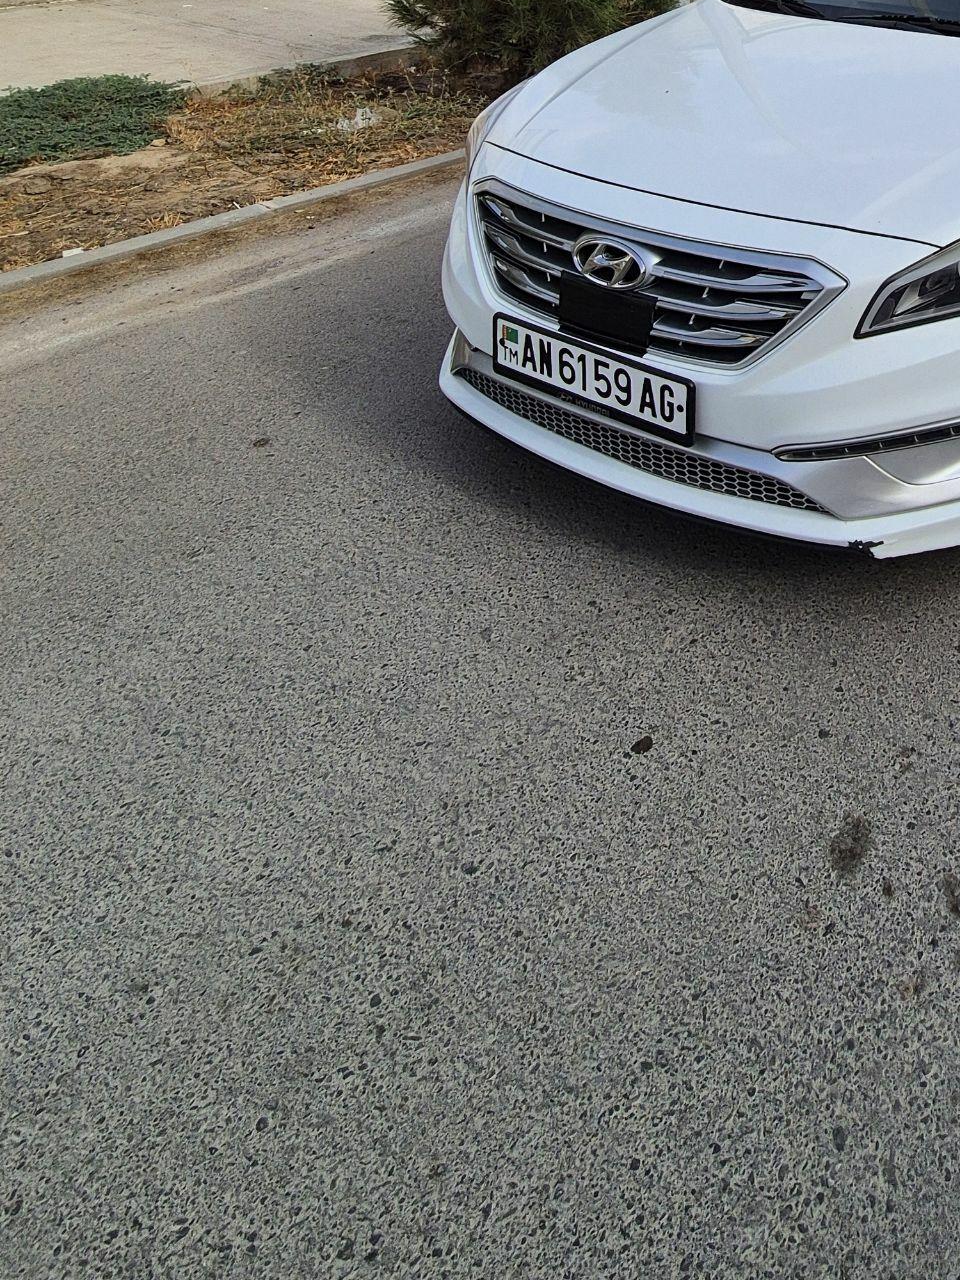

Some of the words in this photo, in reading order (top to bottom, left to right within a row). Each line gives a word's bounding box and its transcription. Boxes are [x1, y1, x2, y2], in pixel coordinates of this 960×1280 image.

[504, 346, 519, 365] TM
[522, 334, 552, 378] AN
[558, 347, 632, 406] 6159
[639, 377, 675, 423] AG
